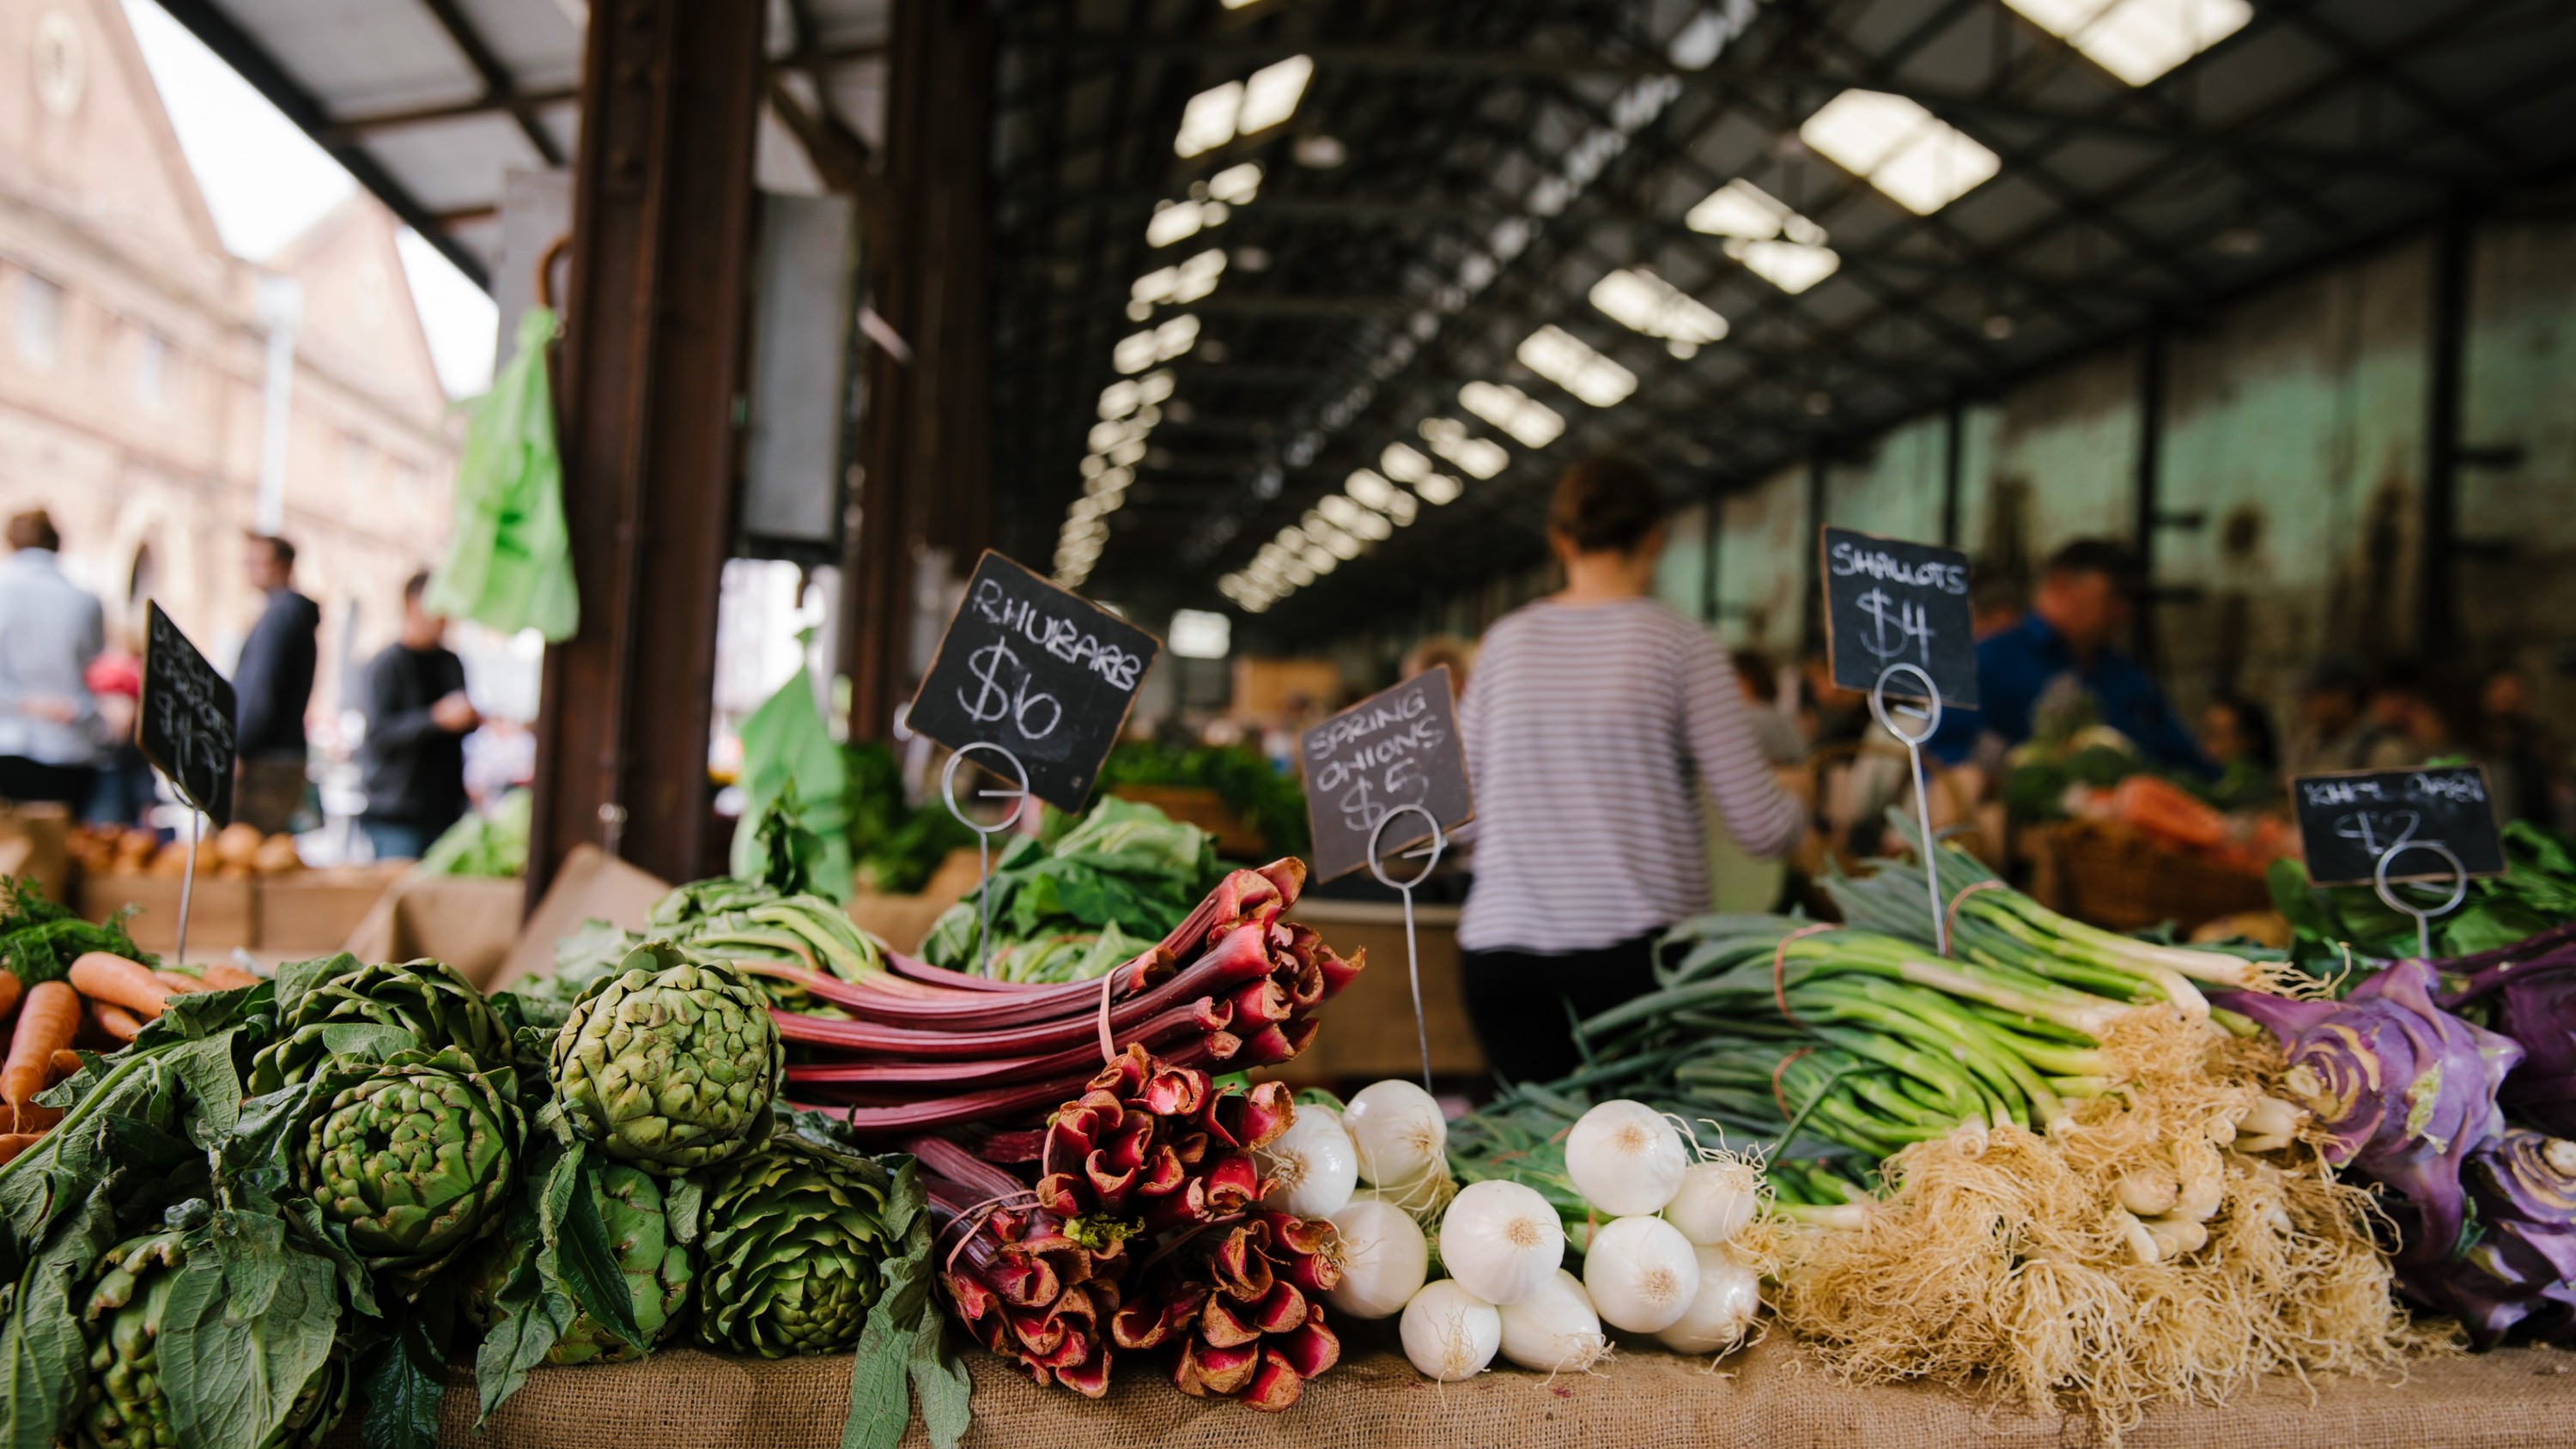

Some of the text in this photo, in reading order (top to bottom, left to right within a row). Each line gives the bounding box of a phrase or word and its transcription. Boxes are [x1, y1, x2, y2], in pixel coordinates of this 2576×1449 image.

[1832, 542, 1968, 595] SHALLOTS
[972, 578, 1141, 691] RHUBARB
[1856, 585, 1936, 669] $4
[957, 635, 1062, 740] $6
[1309, 688, 1427, 761] SPRING
[1316, 714, 1446, 791] ONIONS
[1339, 756, 1430, 832] $5
